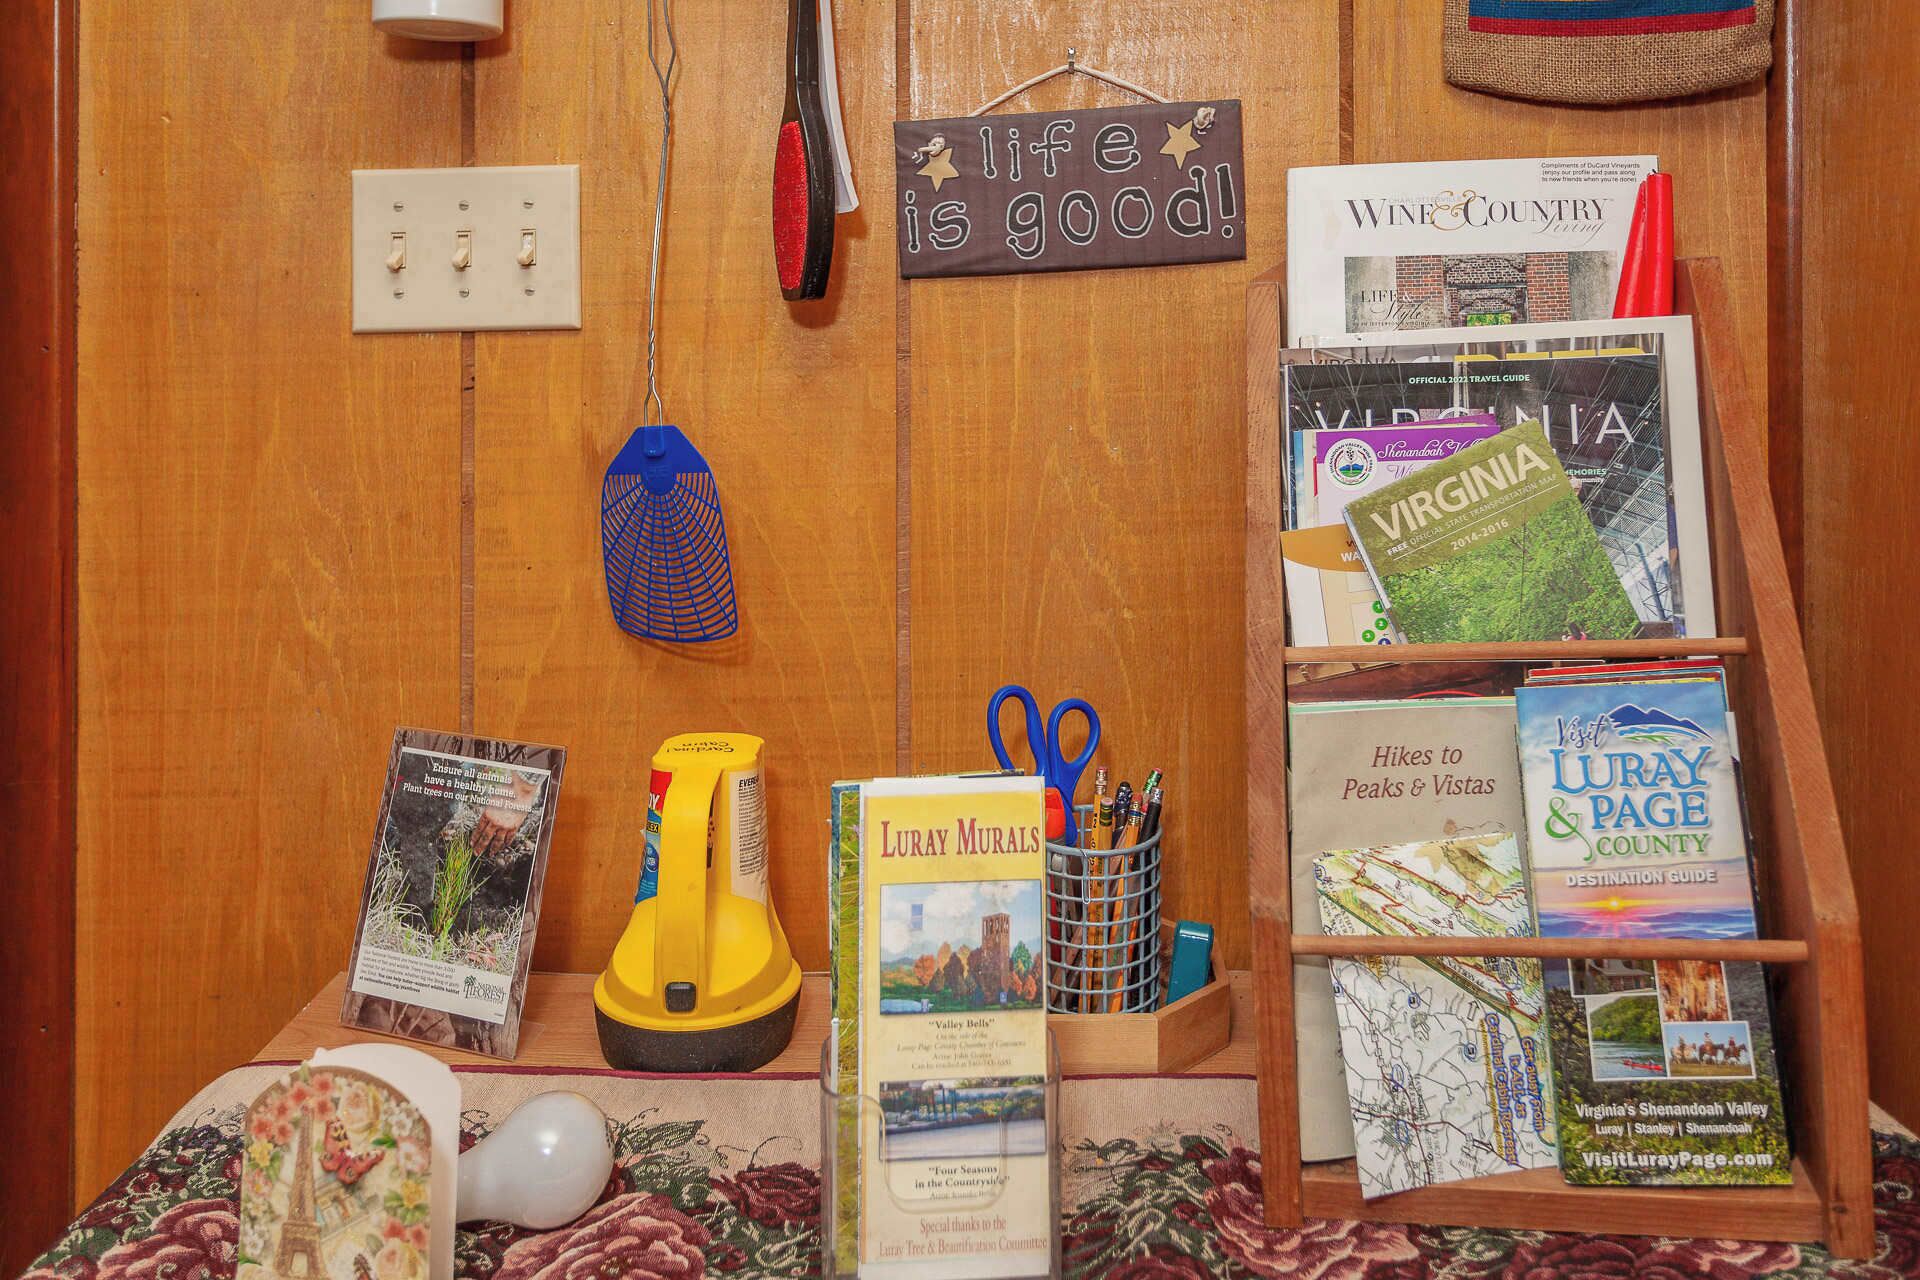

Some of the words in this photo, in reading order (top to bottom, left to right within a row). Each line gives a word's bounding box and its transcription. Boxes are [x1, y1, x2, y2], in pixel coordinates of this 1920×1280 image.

[981, 120, 1141, 181] life
[906, 190, 970, 253] is
[1007, 164, 1236, 260] good!
[1344, 199, 1435, 229] WINE
[1463, 196, 1610, 227] COUNTRY
[1360, 290, 1399, 302] LIFE
[1408, 376, 1447, 385] OFFICIAL
[1448, 376, 1468, 384] 2022
[1469, 375, 1502, 383] TRAVEL
[1503, 374, 1530, 382] GUIDE
[1377, 440, 1444, 458] Shenandoah
[1369, 443, 1551, 541] VIRGINIA
[1387, 542, 1409, 556] FREE
[1410, 526, 1444, 545] OFFICIAL
[1445, 515, 1469, 530] STATE
[1470, 482, 1537, 518] TRANSPORTATION
[1450, 518, 1510, 551] 2014-2016
[1557, 714, 1608, 748] Visit
[1371, 745, 1433, 768] Hikes
[1441, 745, 1463, 765] to
[433, 763, 463, 776] Ensure
[464, 768, 475, 778] all
[477, 770, 513, 784] animals
[1549, 745, 1713, 794] LURAY
[403, 782, 422, 794] Plant
[423, 785, 443, 797] trees
[443, 791, 454, 799] on
[455, 793, 469, 802] our
[470, 794, 503, 807] National
[424, 774, 445, 786] have
[454, 779, 488, 795] healthy
[1342, 777, 1405, 800] Peaks
[1410, 778, 1426, 797] &
[1432, 774, 1496, 797] Vistas
[881, 820, 950, 858] LURAY
[956, 818, 1040, 855] MURALS
[1544, 797, 1594, 861] &
[1588, 791, 1709, 830] PAGE
[1596, 832, 1710, 857] COUNTY
[1566, 871, 1665, 888] DESTINATION
[1668, 869, 1718, 883] GUIDE
[473, 987, 507, 1001] FOREST
[1485, 1013, 1505, 1071] Cardinal
[1493, 1071, 1511, 1112] Cabin
[1575, 1103, 1637, 1120] Virginia's
[1638, 1102, 1725, 1117] Shenandoah
[1725, 1101, 1769, 1119] Valley
[1595, 1123, 1624, 1136] Luray
[1634, 1123, 1675, 1136] Stanley
[1686, 1122, 1753, 1135] Shenandoah
[960, 1164, 998, 1175] Seasons
[1582, 1151, 1774, 1170] VisitLurayPage.com
[915, 1179, 924, 1189] in
[927, 1179, 943, 1188] the
[920, 1216, 950, 1238] Special
[952, 1216, 981, 1233] thanks
[982, 1217, 992, 1230] to
[993, 1214, 1007, 1230] the
[905, 1239, 926, 1255] Tree
[927, 1241, 936, 1255] &
[998, 1234, 1048, 1250] Committee
